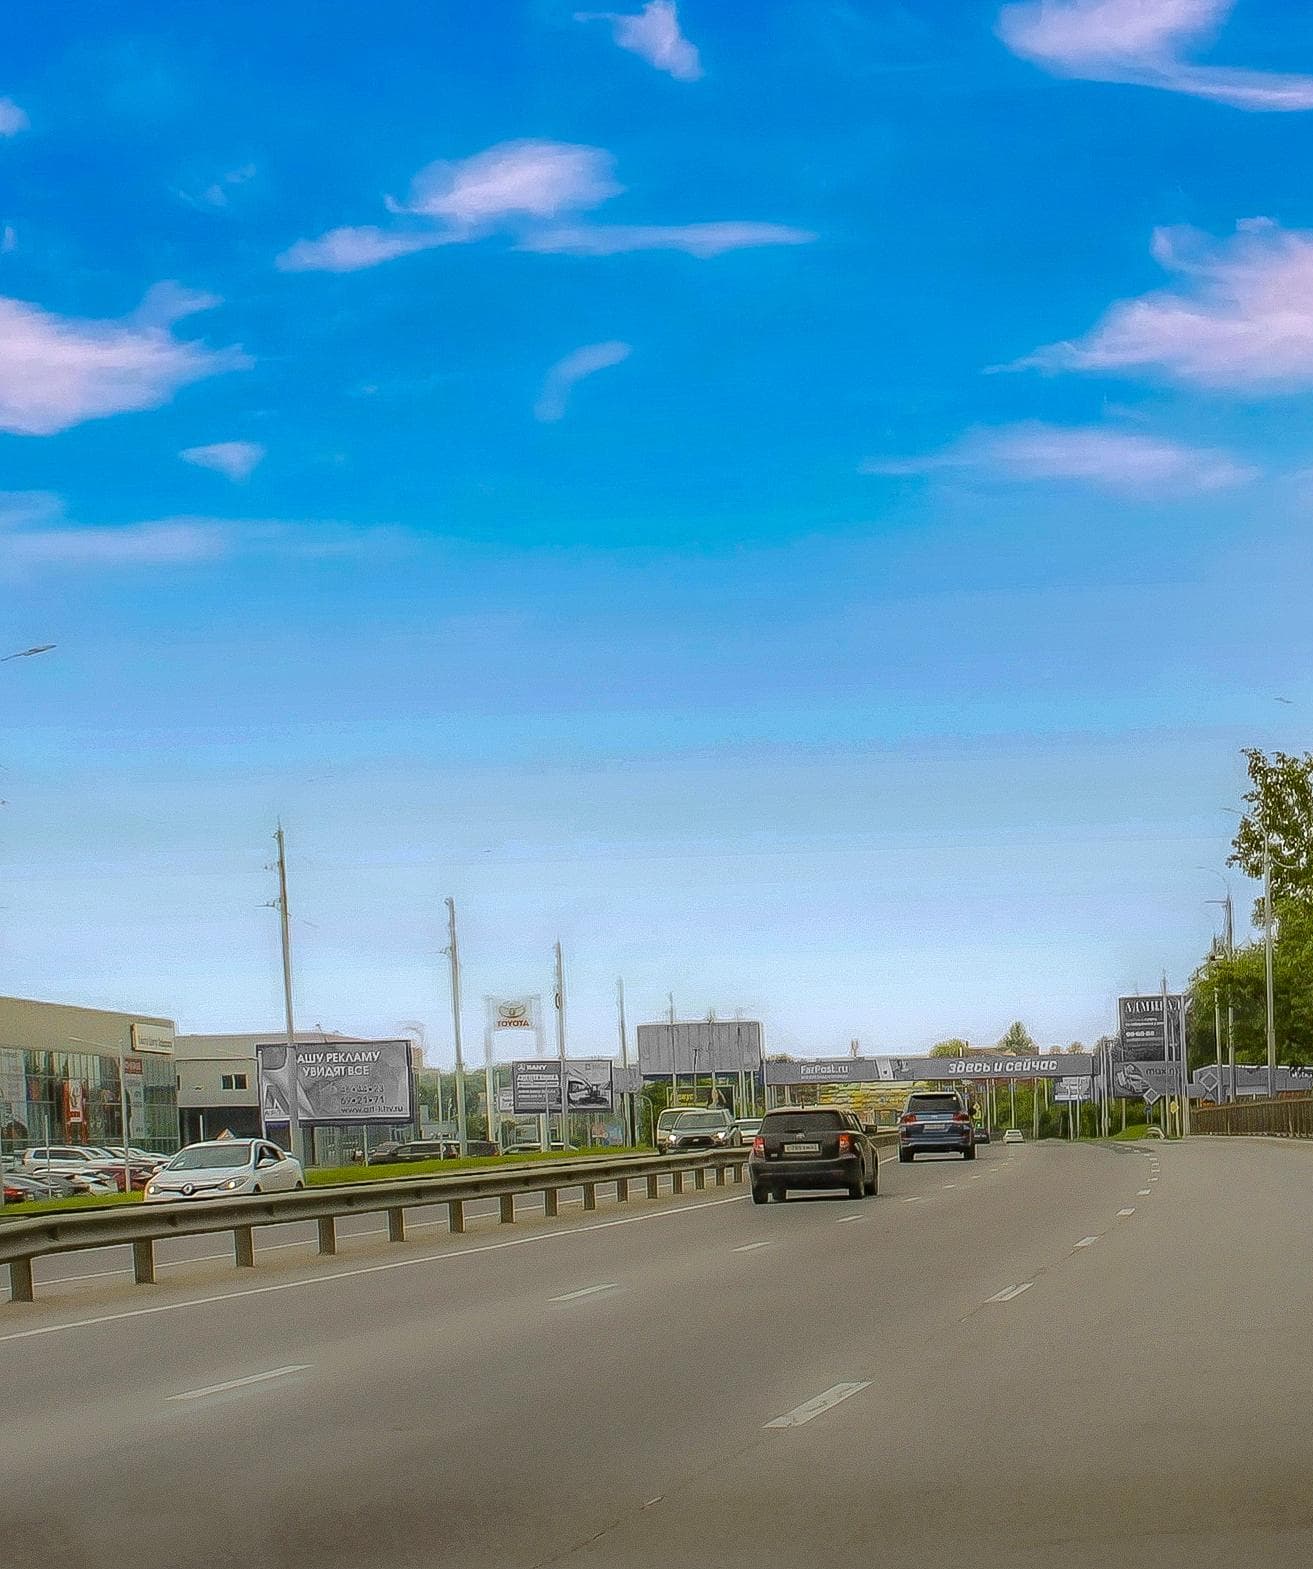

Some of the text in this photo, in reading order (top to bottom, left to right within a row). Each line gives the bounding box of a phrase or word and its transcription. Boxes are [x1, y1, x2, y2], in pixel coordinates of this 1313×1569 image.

[497, 1019, 530, 1028] TOYOTA
[326, 1051, 380, 1063] РЕКЛАМУ
[302, 1066, 346, 1078] УВИДЯТ
[948, 1058, 1058, 1074] здесь и сейчас
